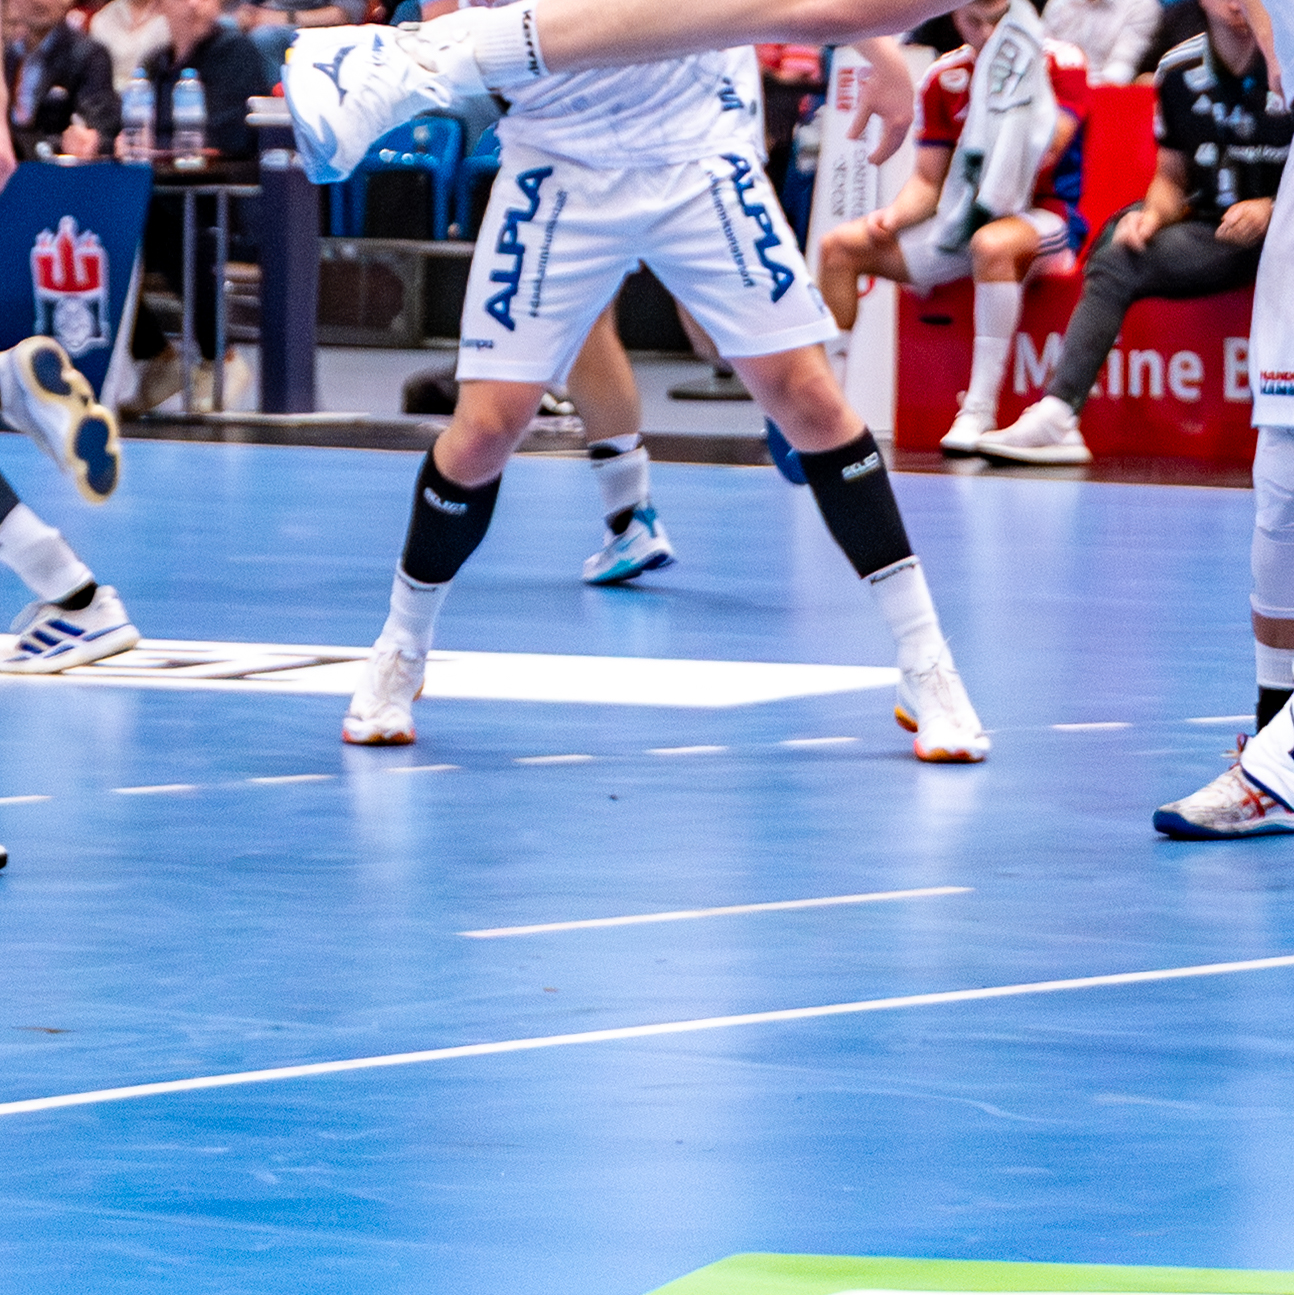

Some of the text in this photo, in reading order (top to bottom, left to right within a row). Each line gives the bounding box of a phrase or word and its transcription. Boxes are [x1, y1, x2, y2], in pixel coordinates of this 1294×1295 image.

[485, 165, 554, 332] ALPLA
[718, 153, 795, 304] ALPLA
[1012, 331, 1204, 404] Mine
